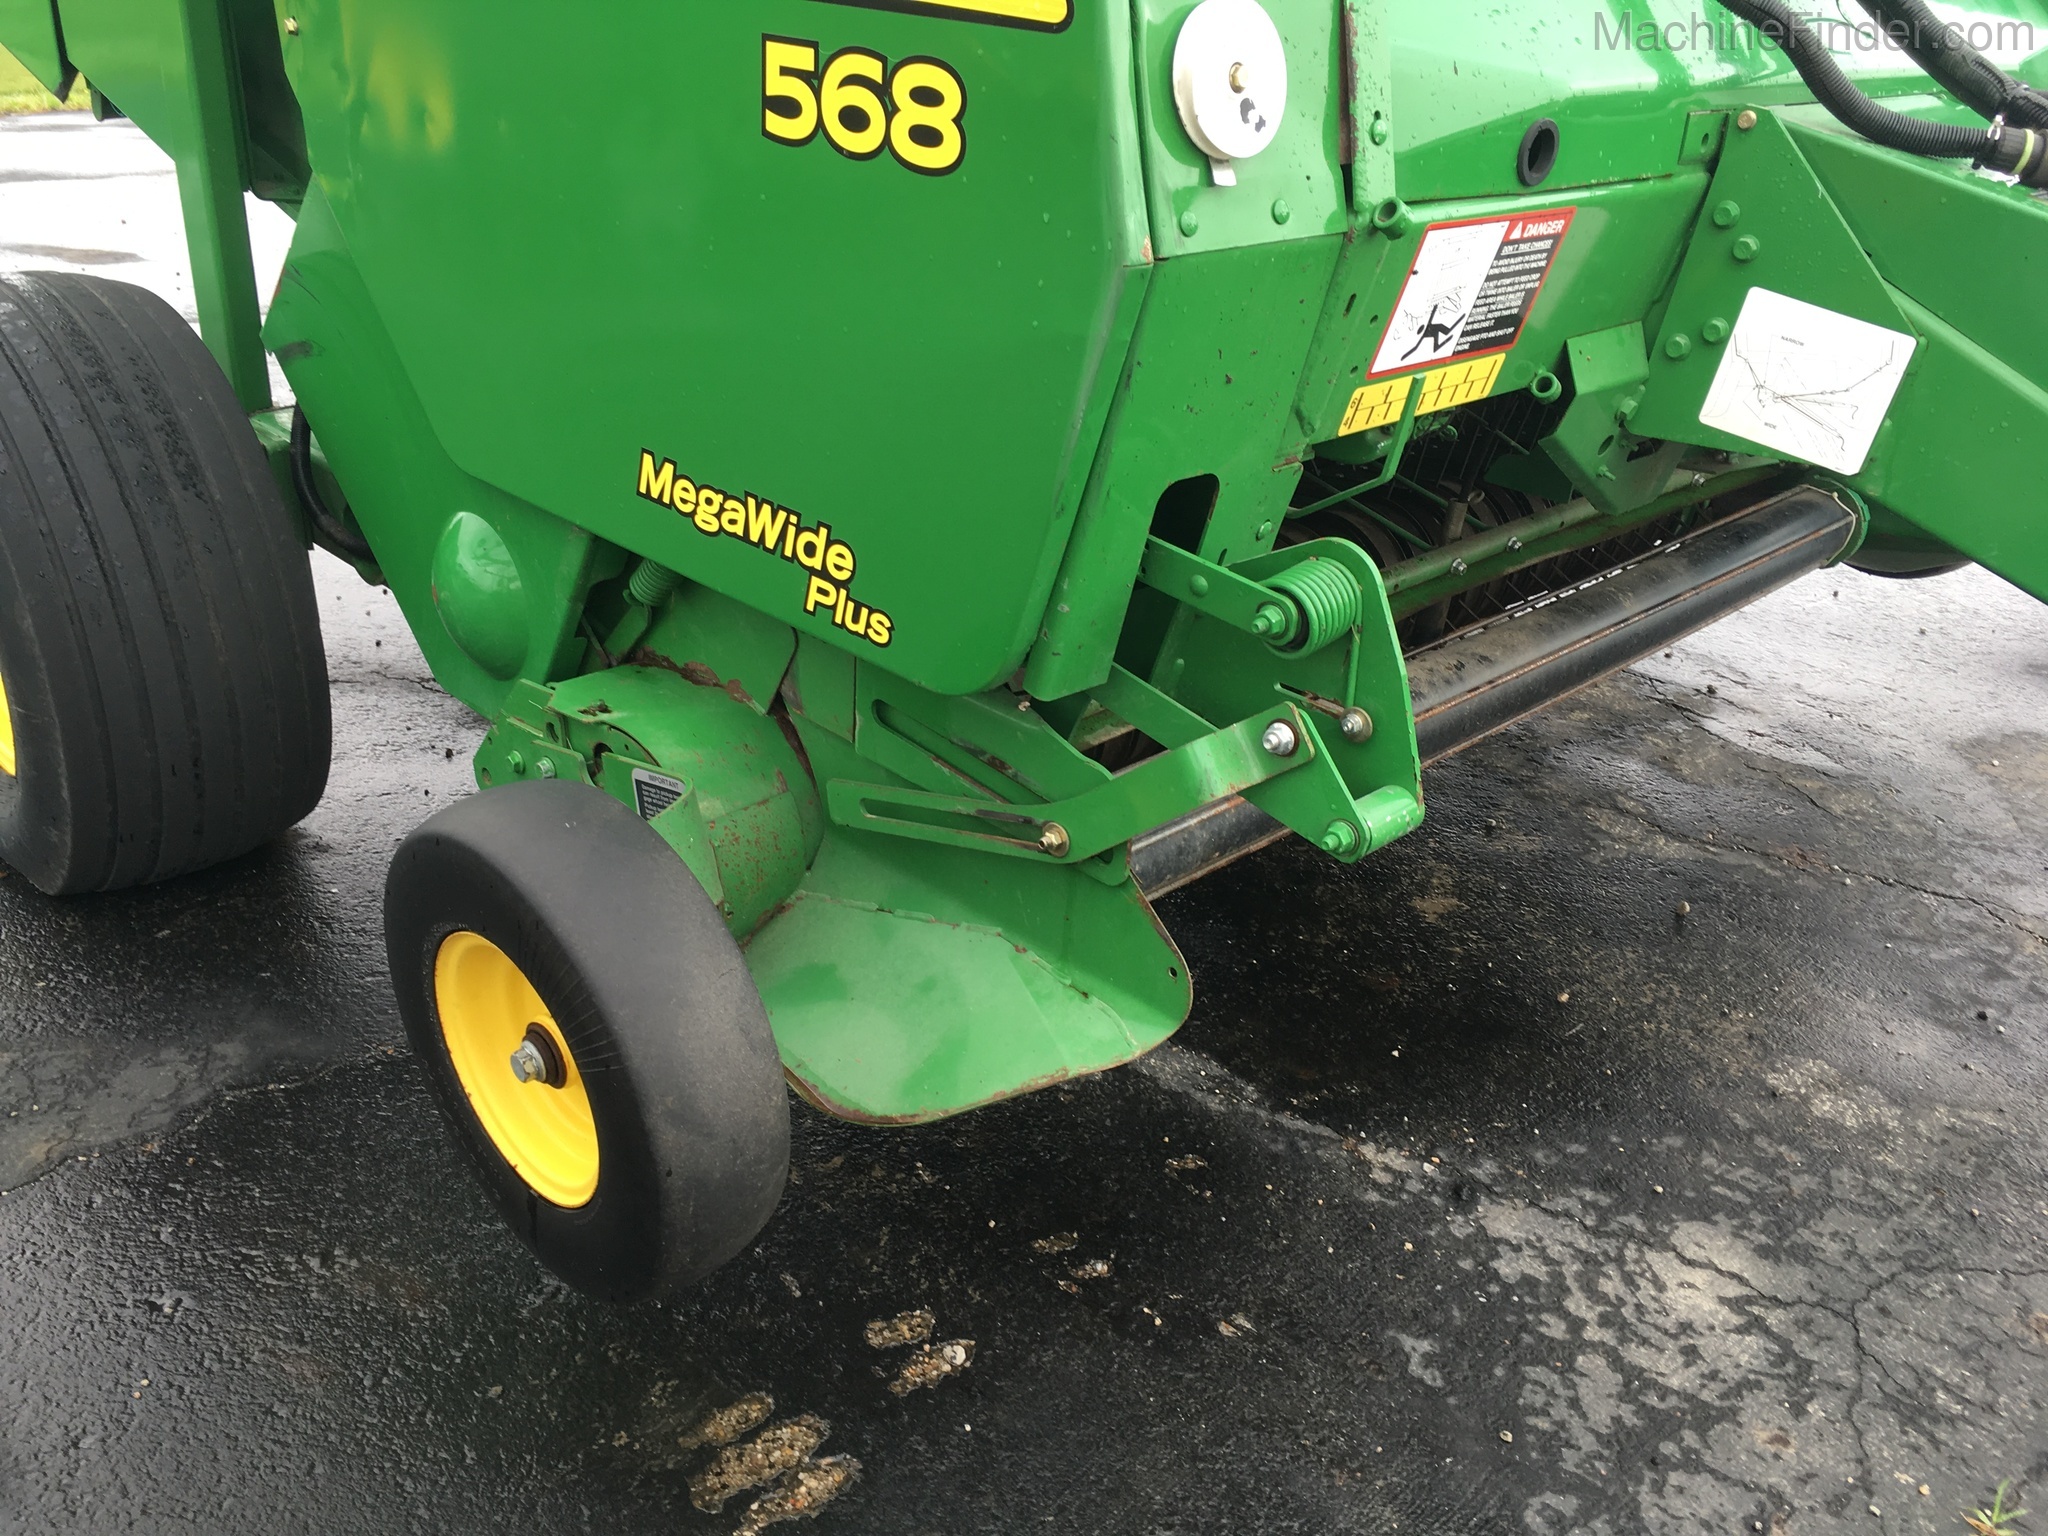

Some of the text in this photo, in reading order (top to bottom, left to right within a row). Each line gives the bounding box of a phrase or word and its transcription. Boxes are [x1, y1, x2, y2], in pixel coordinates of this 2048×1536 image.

[761, 32, 967, 177] 568
[1523, 219, 1565, 238] DANGER
[636, 447, 856, 585] MegaWide
[803, 572, 894, 648] Plus
[648, 774, 678, 789] IMPORTANT
